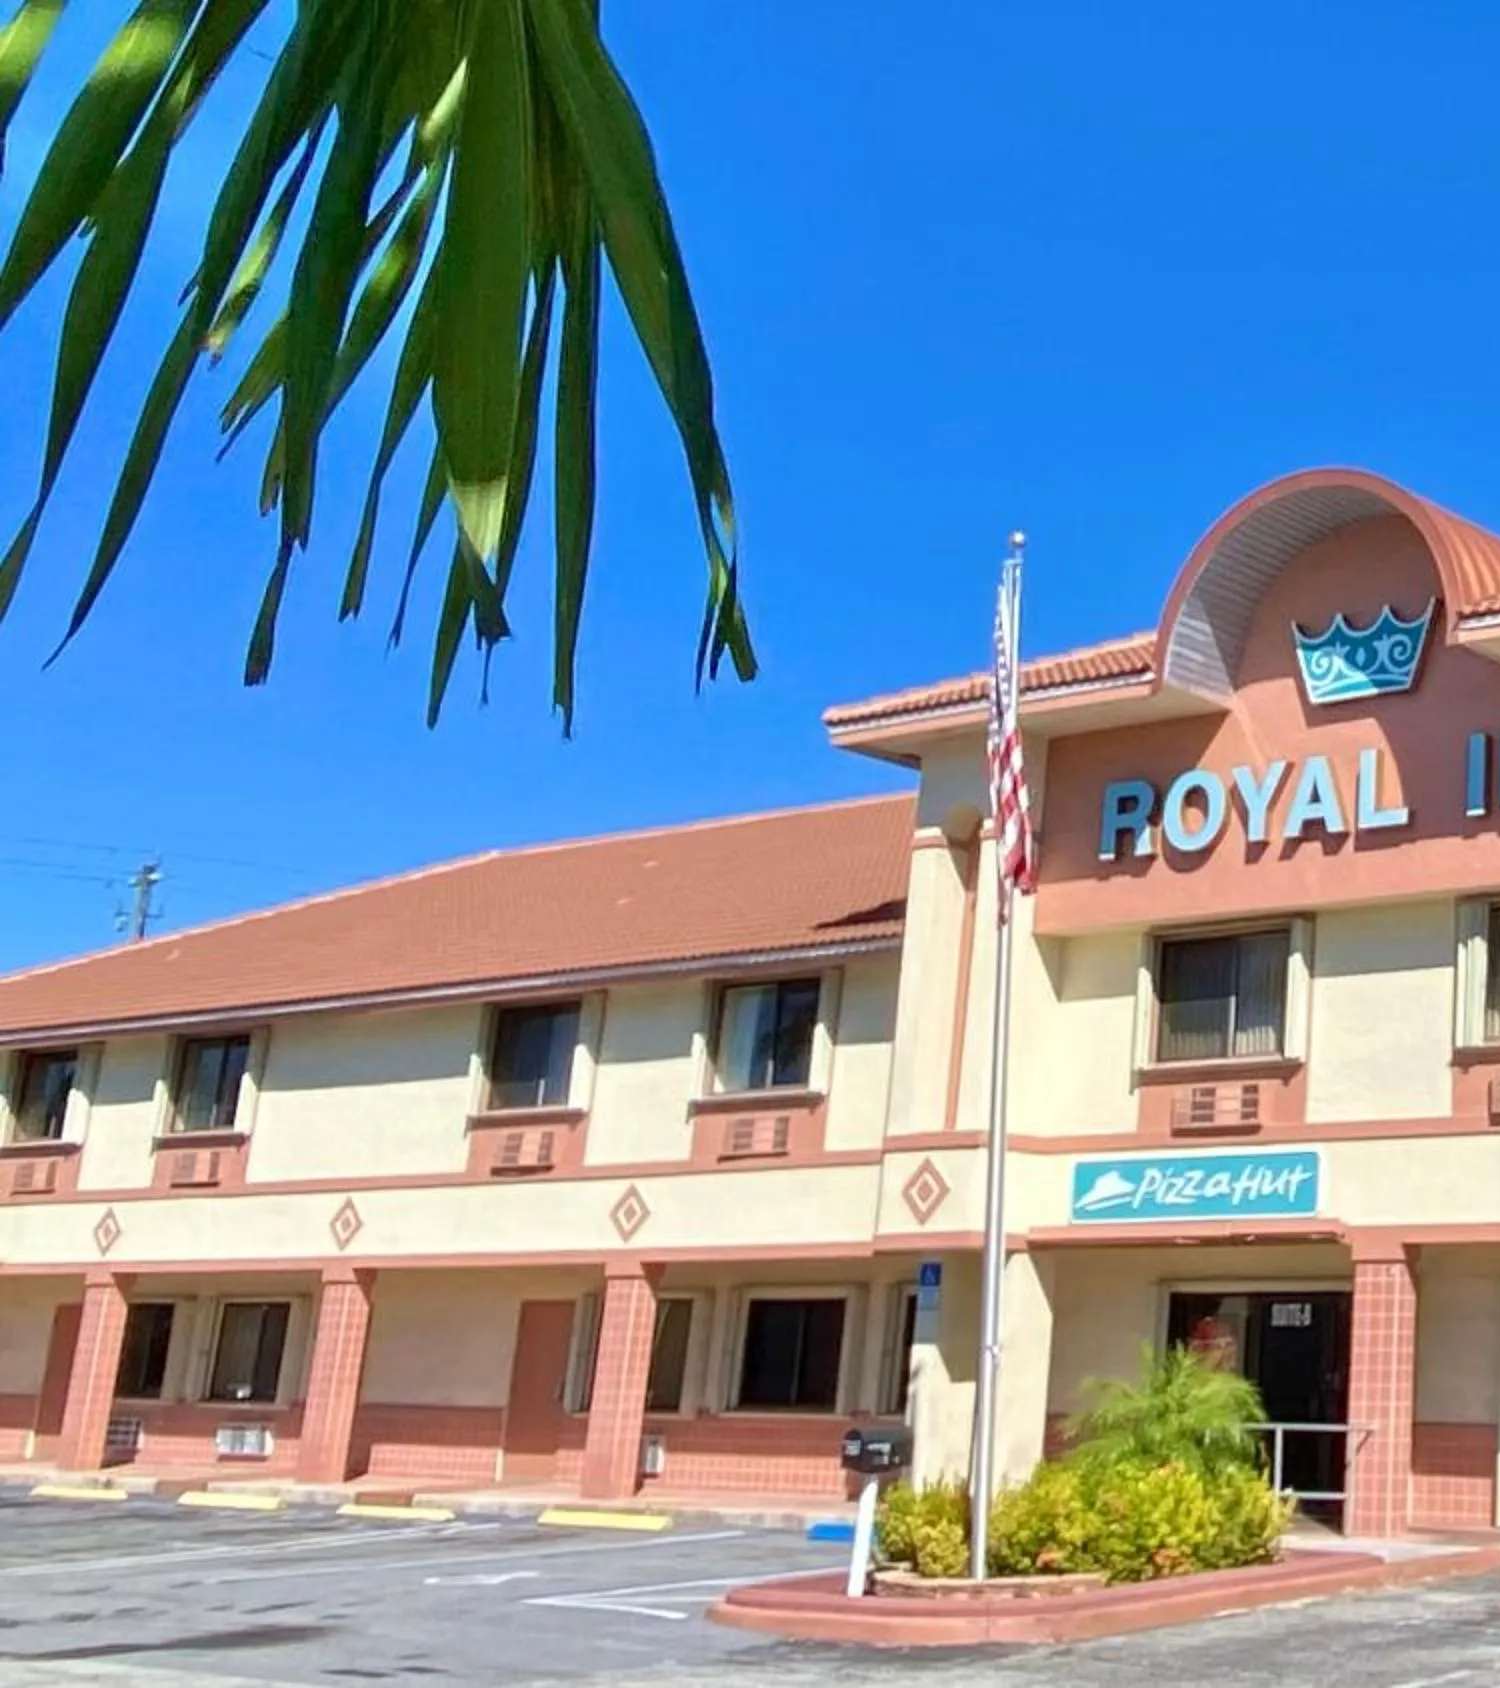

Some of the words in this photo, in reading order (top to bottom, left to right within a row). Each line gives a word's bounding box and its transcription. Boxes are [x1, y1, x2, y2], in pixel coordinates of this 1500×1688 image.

[1098, 748, 1410, 860] ROYAL
[1132, 1166, 1231, 1209] Pizza
[1231, 1163, 1313, 1206] Hut
